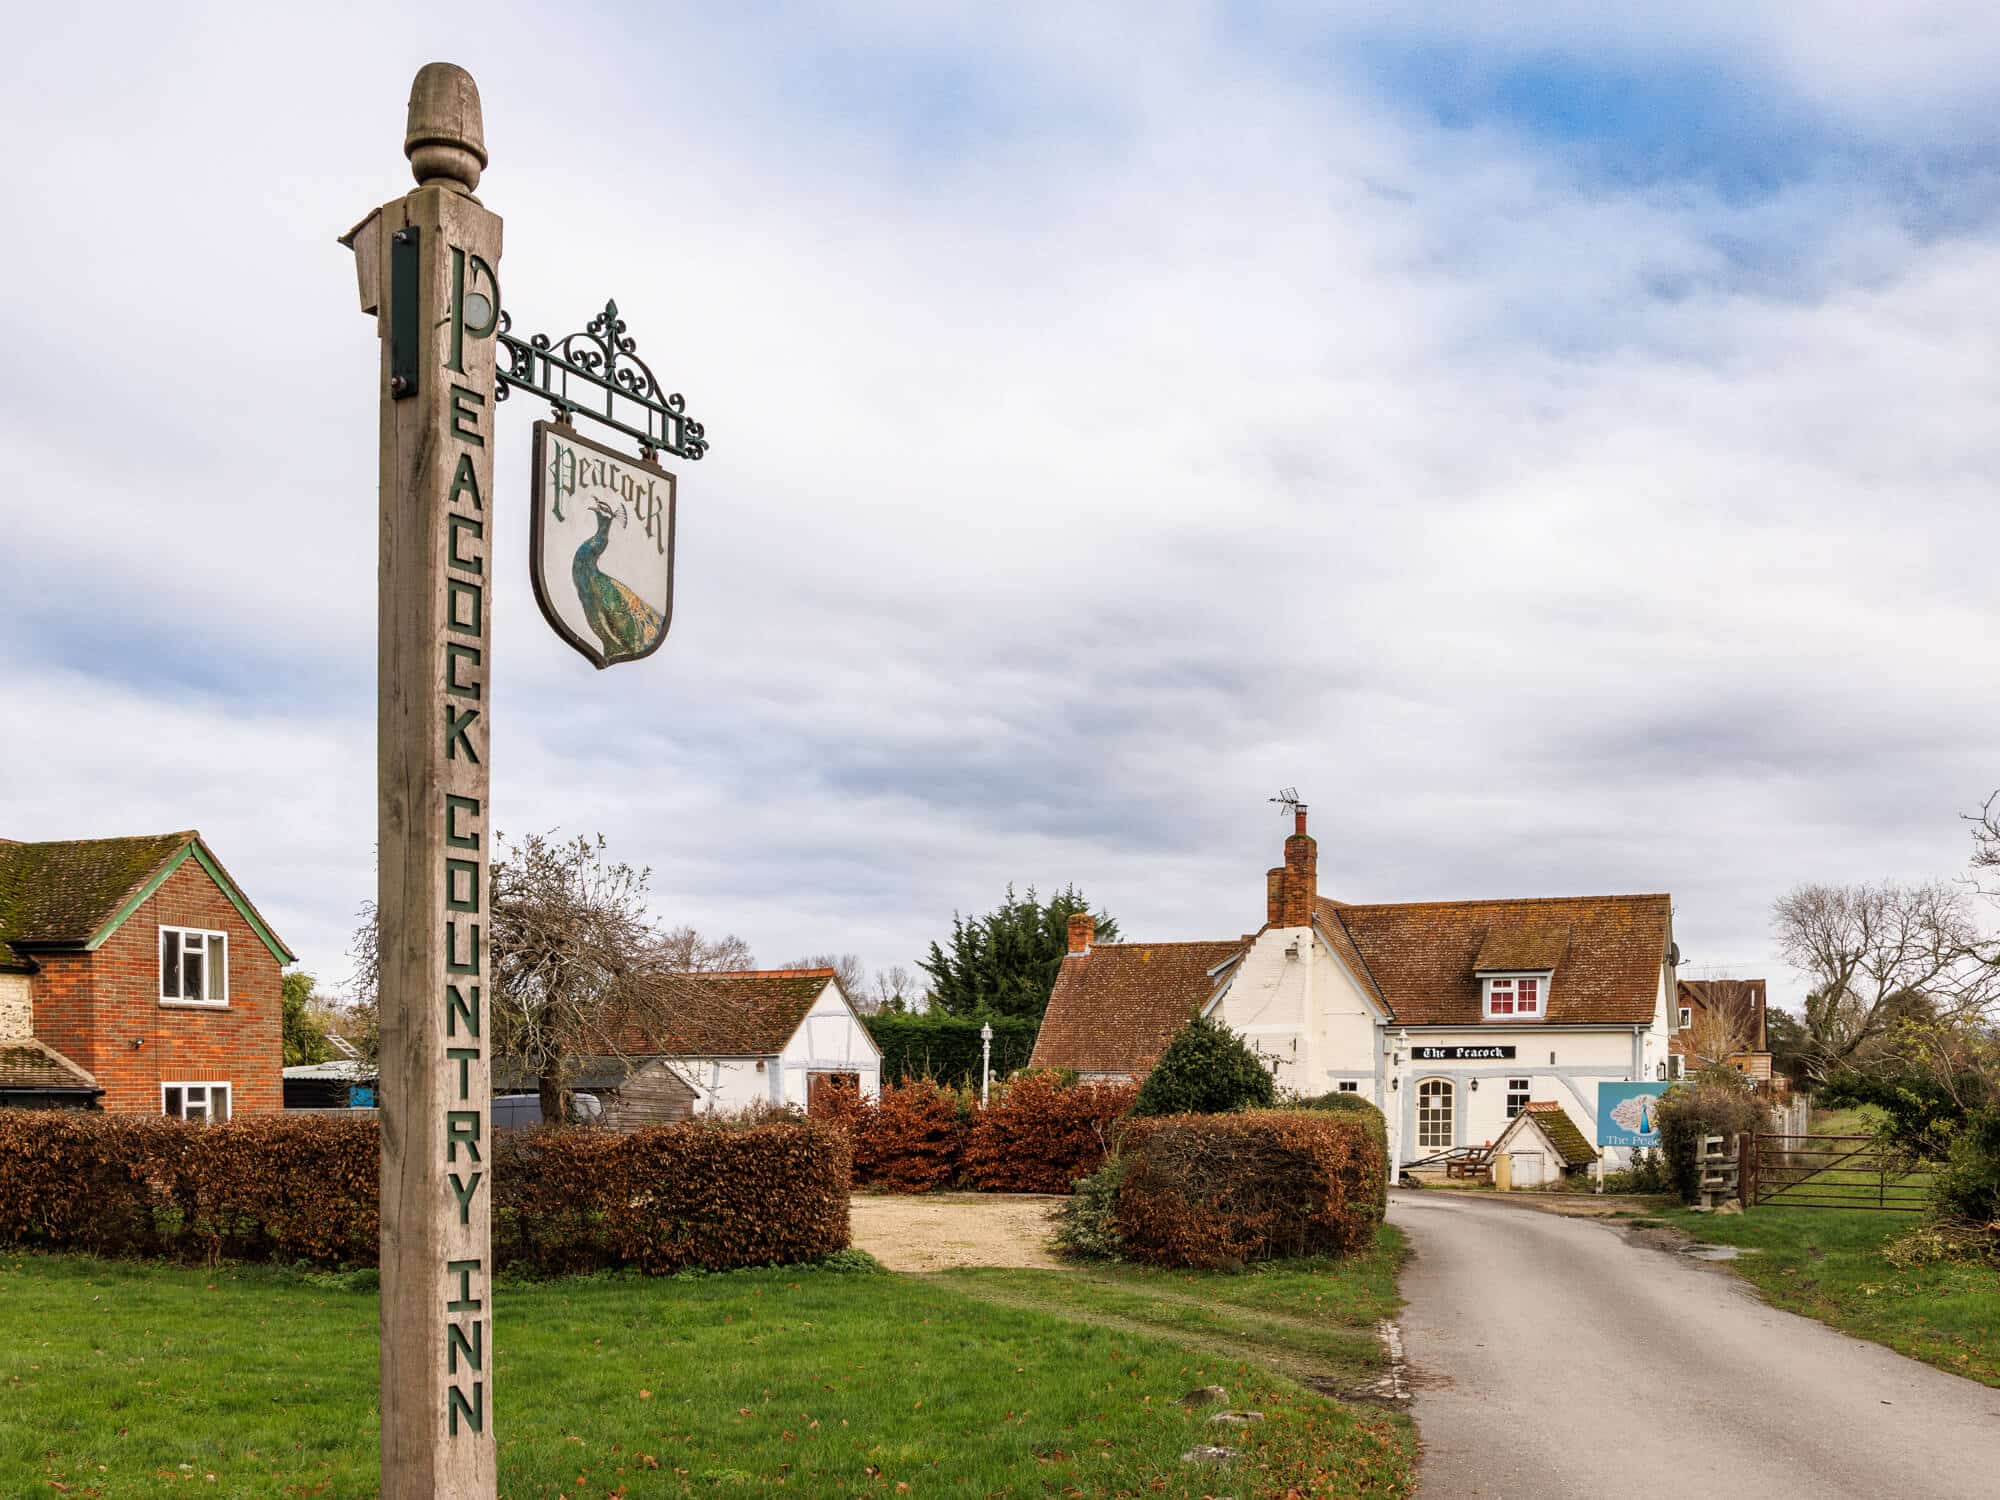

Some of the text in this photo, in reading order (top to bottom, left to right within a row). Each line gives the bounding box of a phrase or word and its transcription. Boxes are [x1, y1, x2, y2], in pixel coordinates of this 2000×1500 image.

[548, 438, 665, 555] Peacock
[435, 244, 499, 1437] PEACOCK COUNTRY INN
[1423, 1047, 1504, 1058] The Peacock
[1606, 1135, 1661, 1145] The Peac
